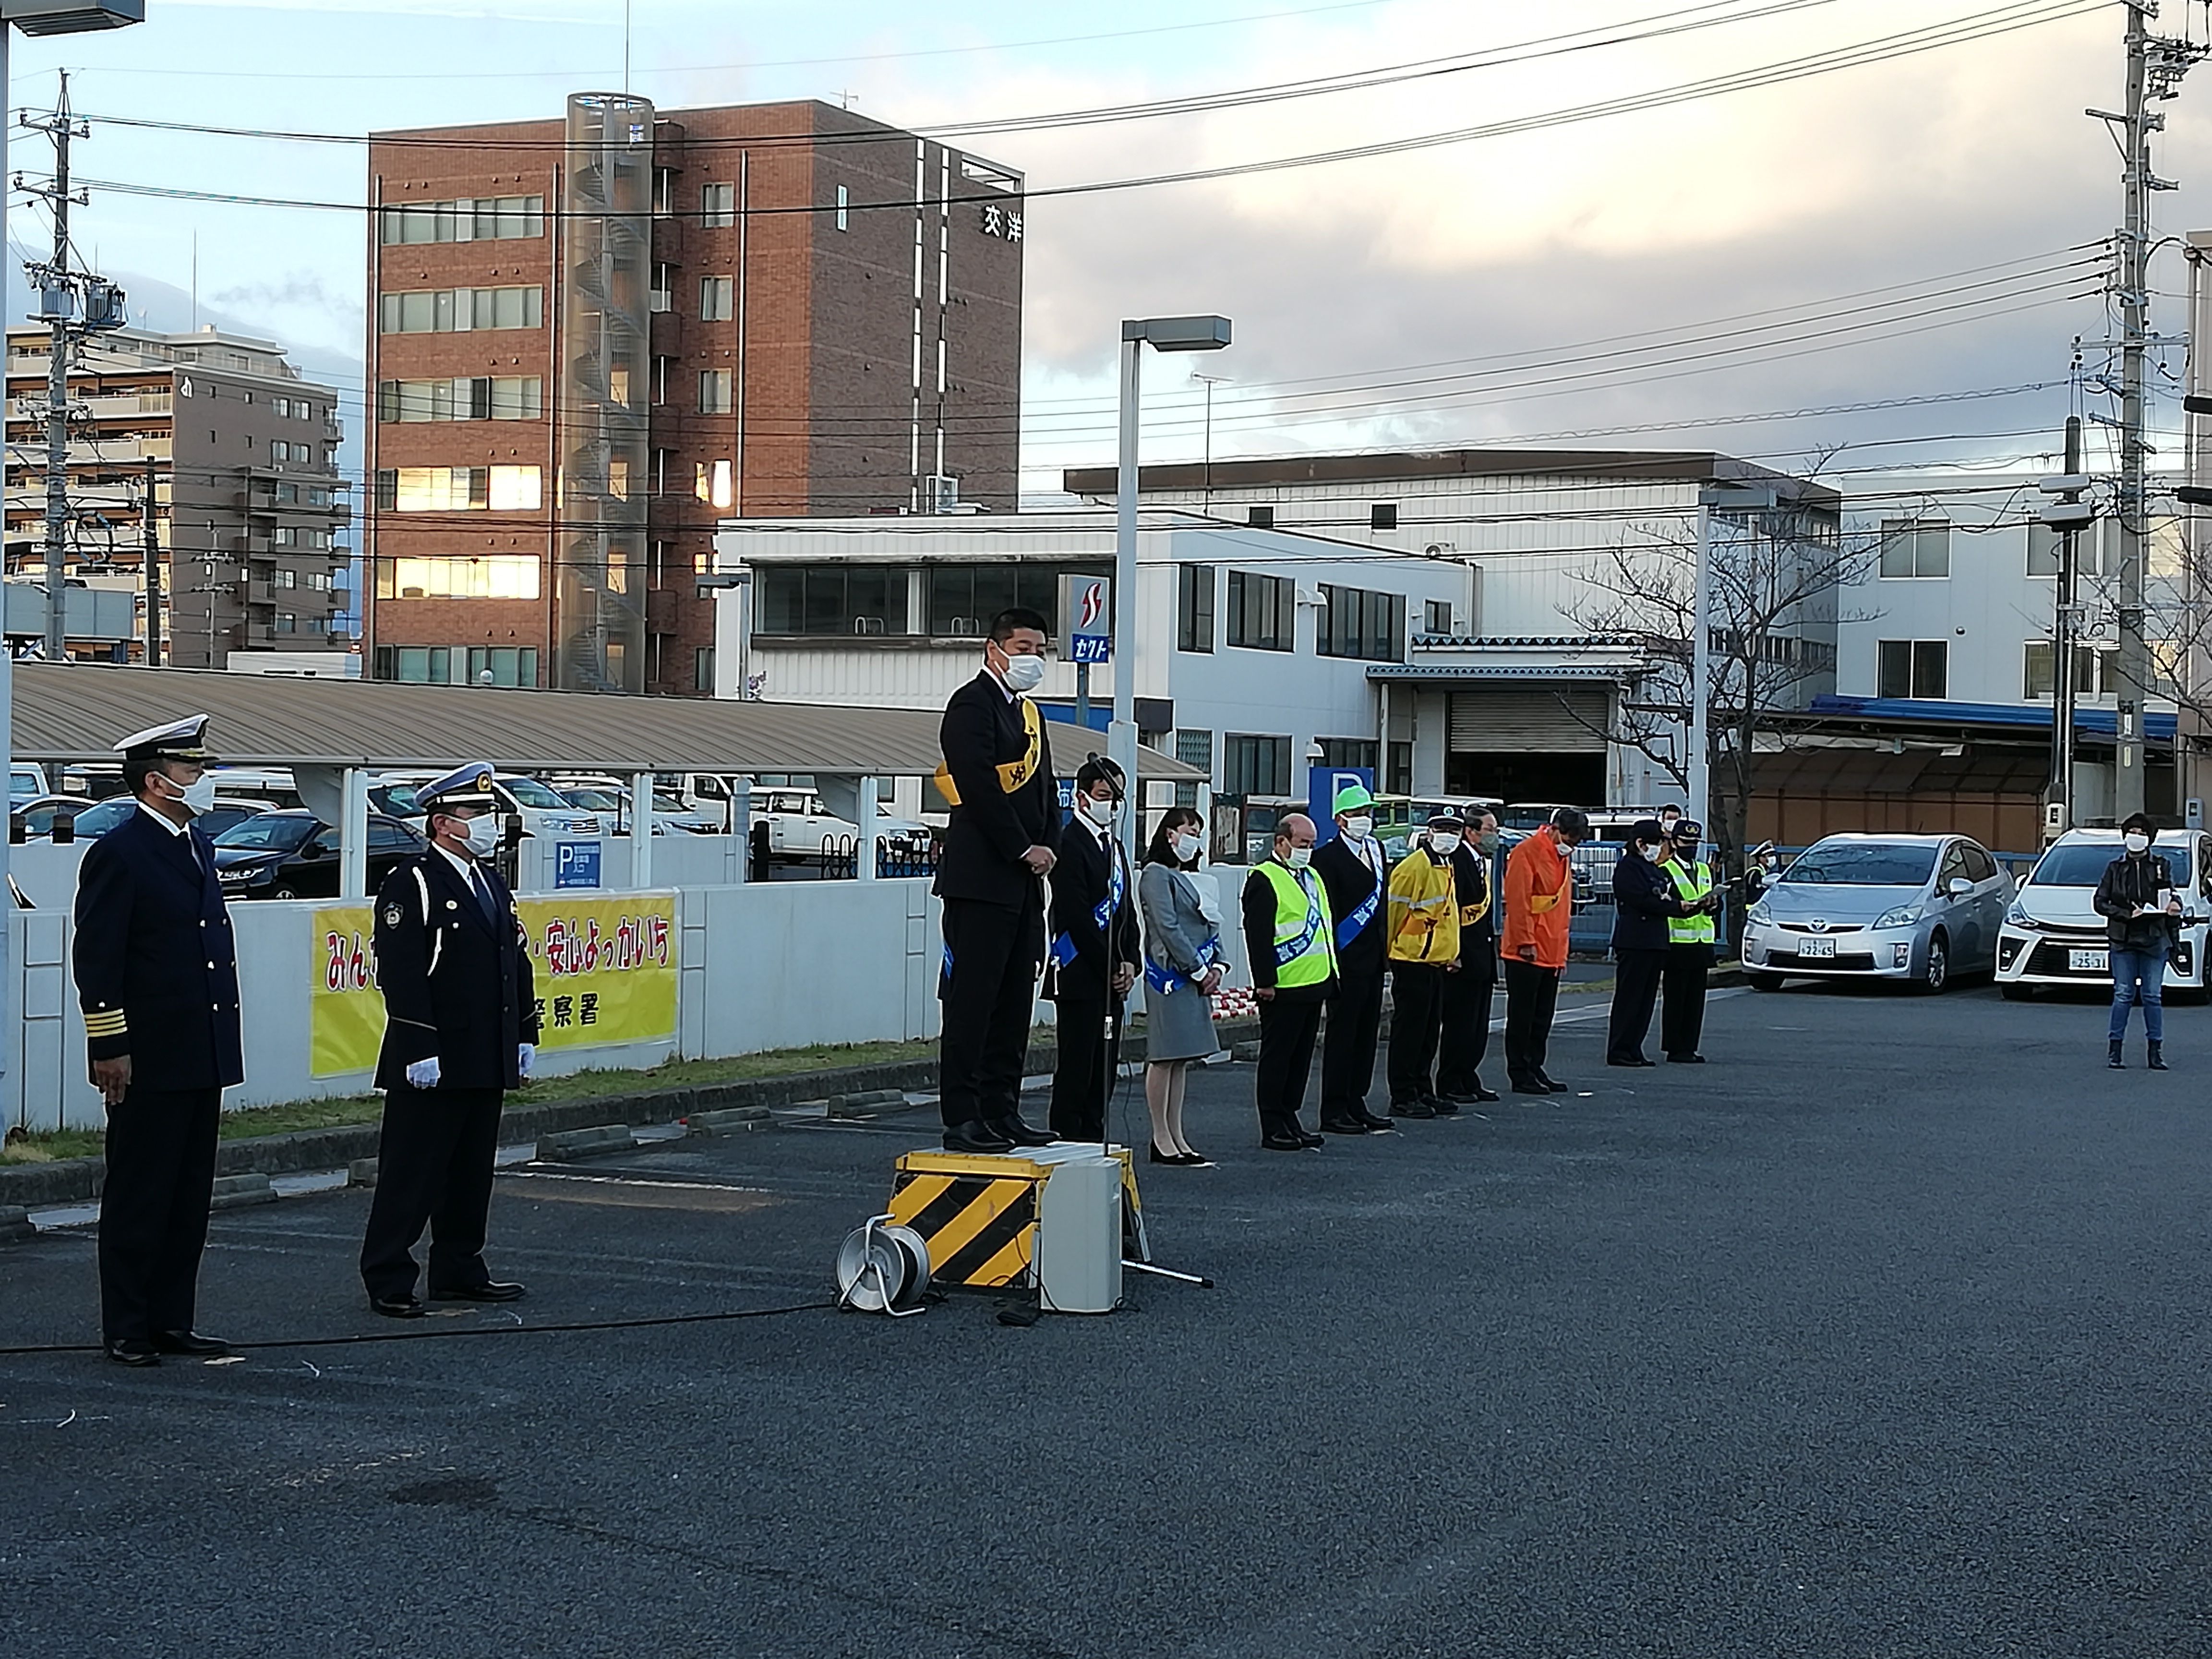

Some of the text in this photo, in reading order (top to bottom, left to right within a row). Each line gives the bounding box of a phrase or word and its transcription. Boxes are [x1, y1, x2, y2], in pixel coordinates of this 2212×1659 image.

[1076, 638, 1106, 659] セクト
[560, 845, 573, 874] P
